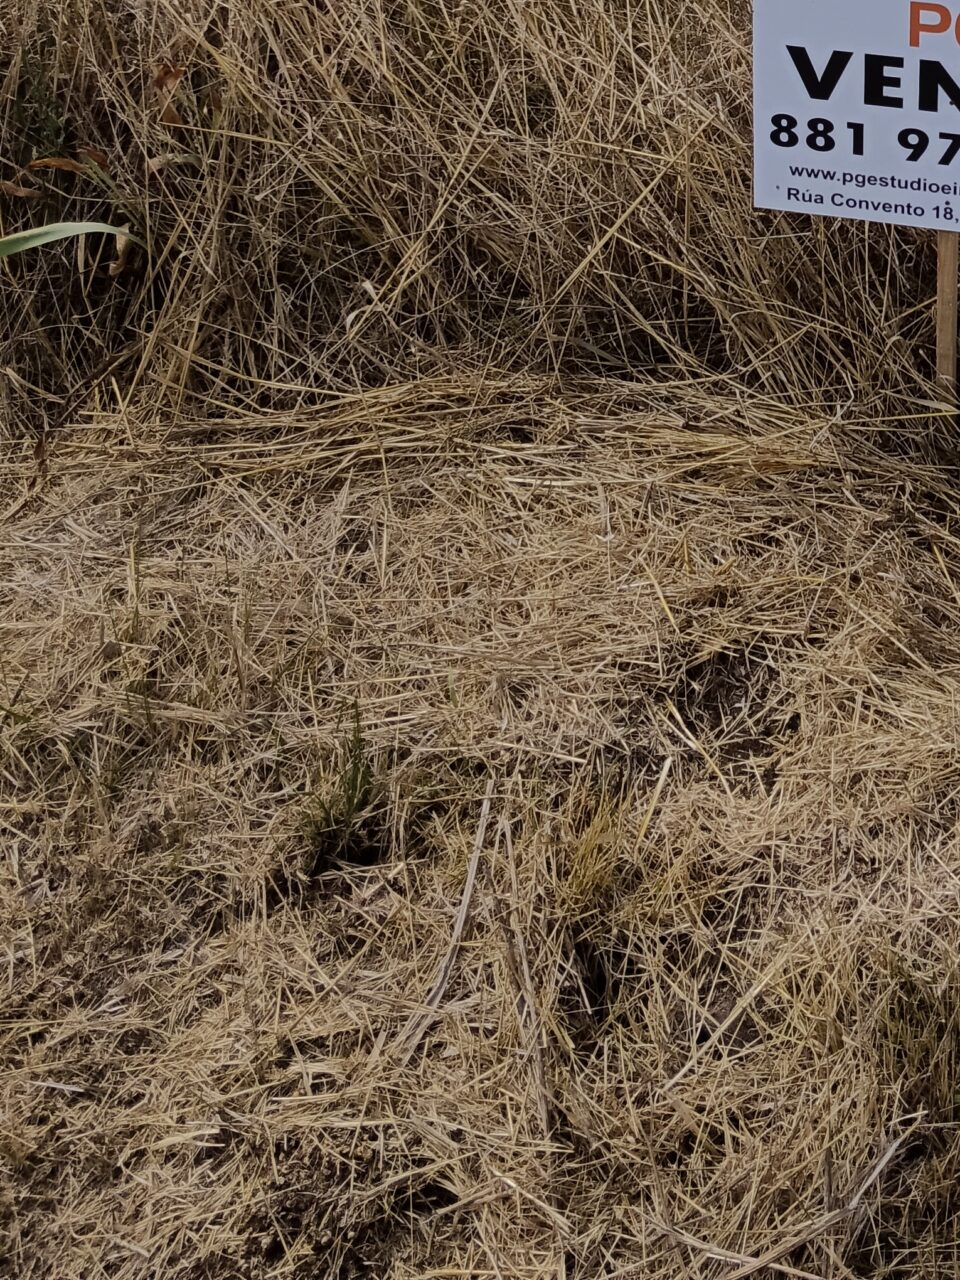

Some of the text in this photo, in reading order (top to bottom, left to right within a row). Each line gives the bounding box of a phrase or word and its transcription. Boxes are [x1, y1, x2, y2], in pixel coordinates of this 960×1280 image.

[769, 113, 865, 156] 881
[787, 187, 824, 205] Rúa
[830, 192, 925, 218] Convento
[932, 205, 960, 224] 18,
